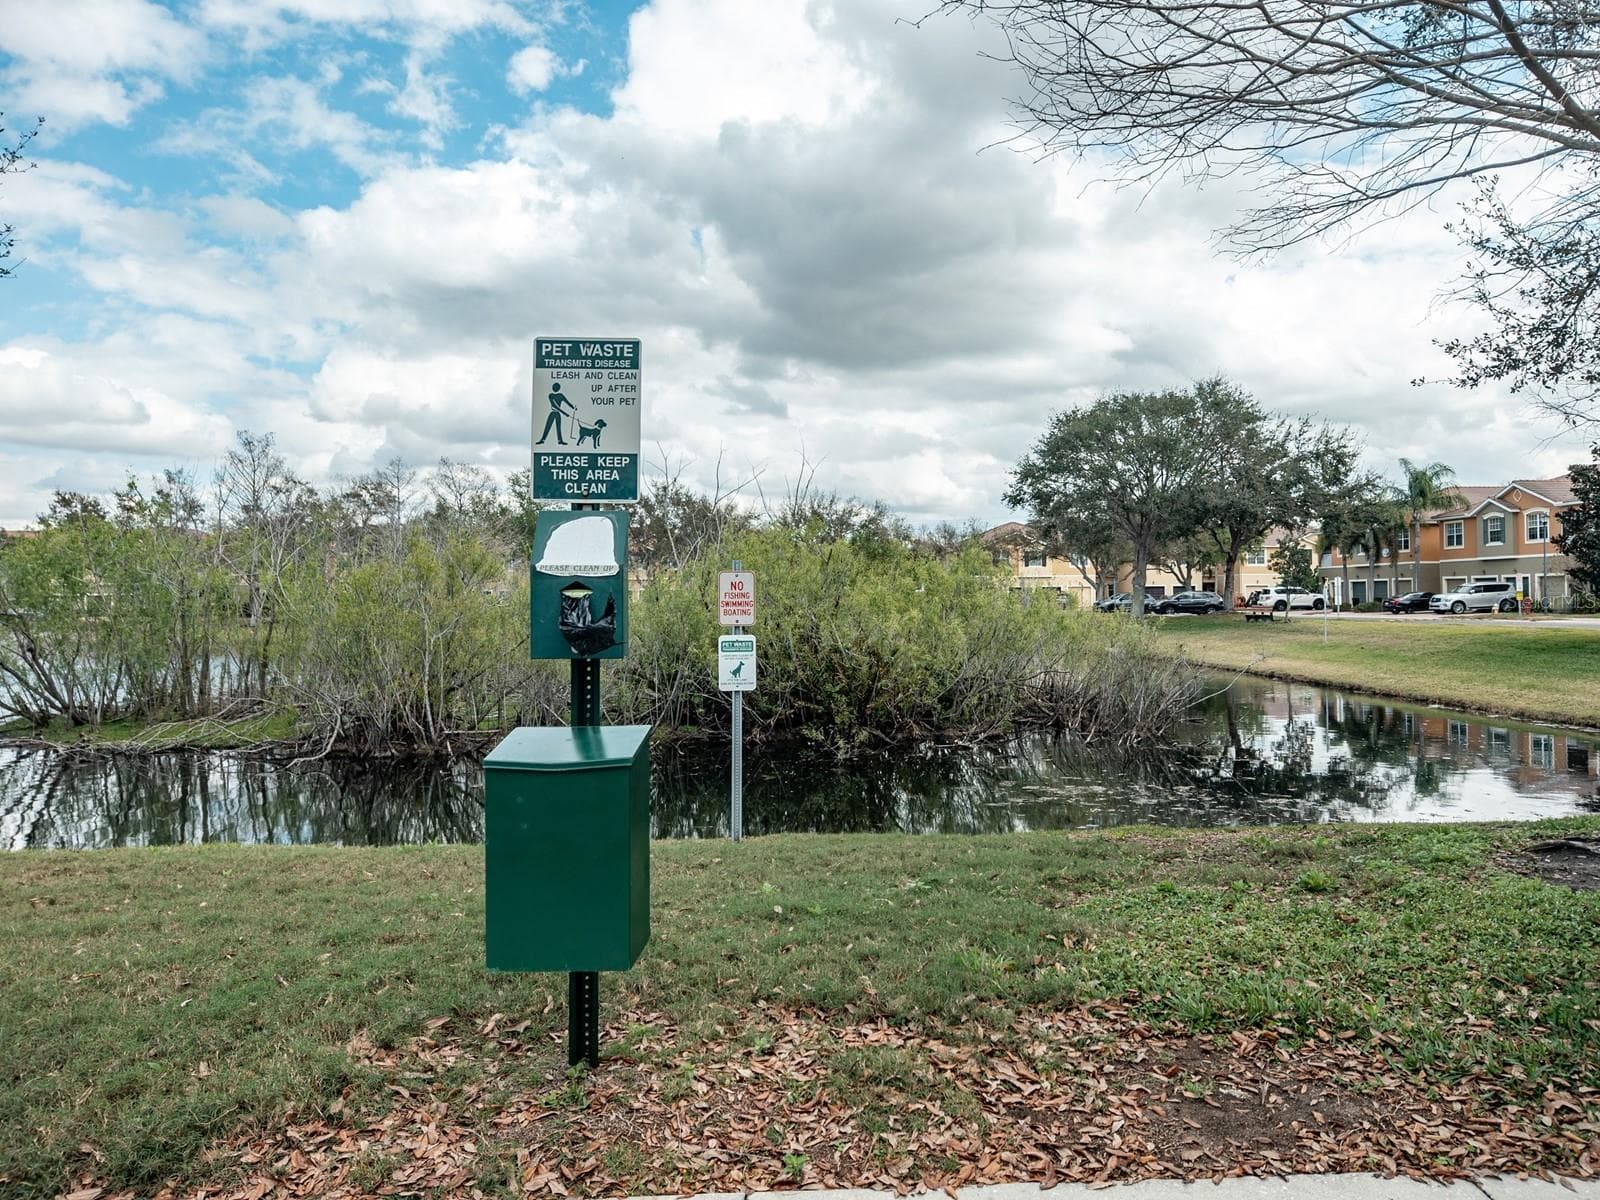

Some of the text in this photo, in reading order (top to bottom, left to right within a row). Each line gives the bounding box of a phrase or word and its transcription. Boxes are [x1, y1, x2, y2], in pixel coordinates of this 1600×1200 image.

[541, 343, 634, 357] PET WASTE
[544, 359, 631, 368] TRANSMITS DISEASE
[550, 371, 637, 380] LEASH AND CLEAN
[591, 384, 637, 392] UP AFTER
[591, 397, 636, 406] YOUR PET
[541, 456, 630, 468] PLEASE KEEP
[551, 469, 620, 480] THIS AREA
[564, 482, 606, 494] CLEAN
[730, 581, 744, 591] NO
[724, 592, 750, 600] FISHING
[723, 608, 752, 616] BOATING
